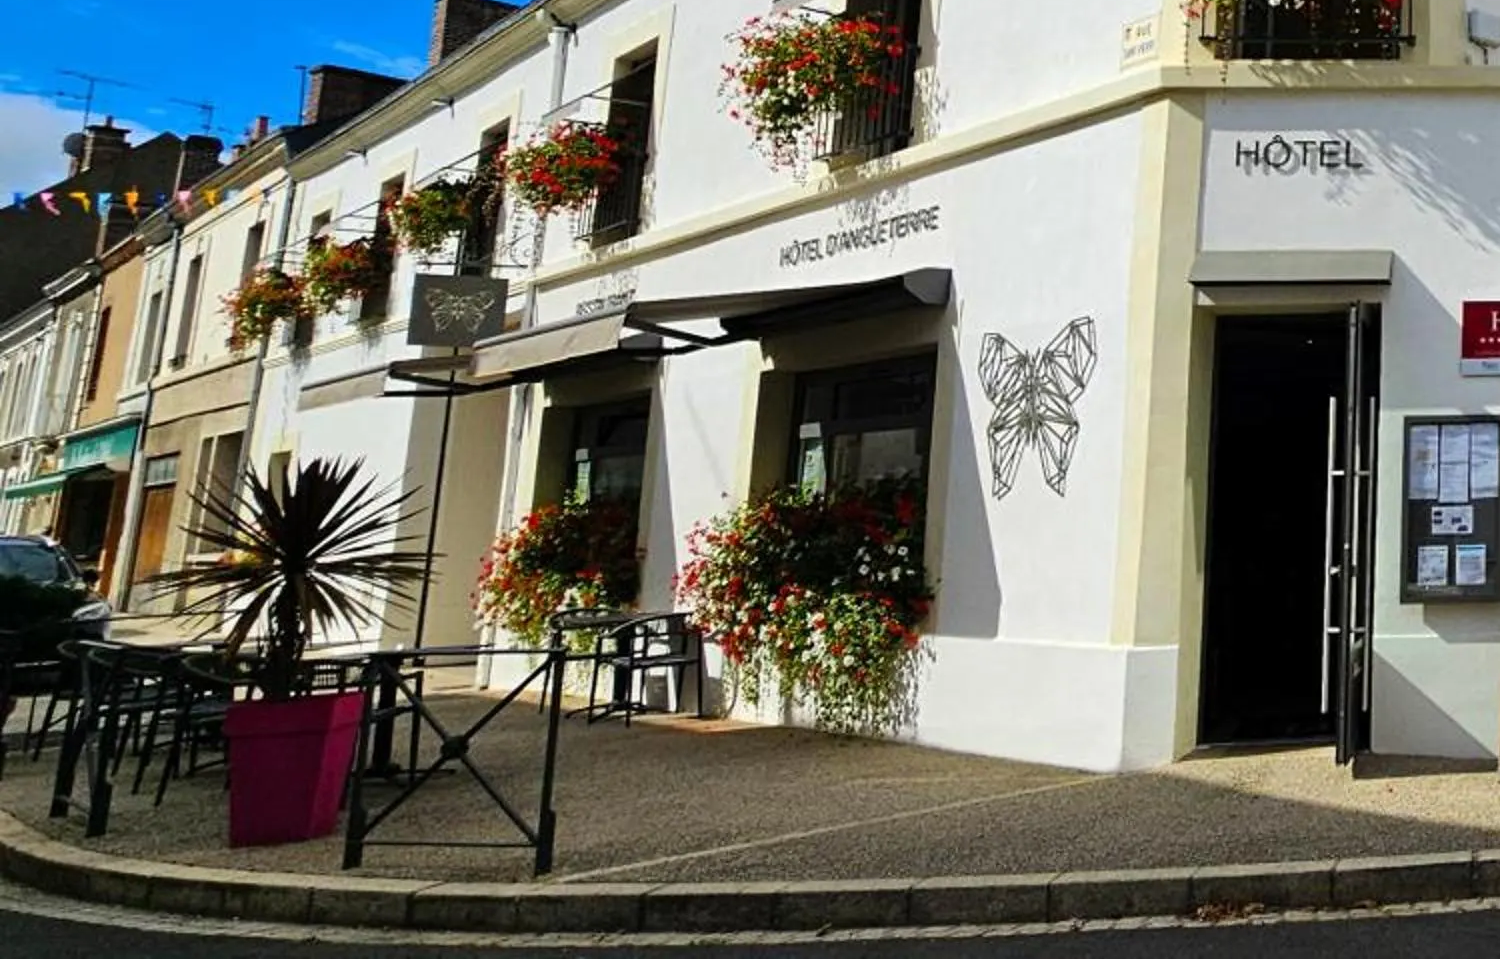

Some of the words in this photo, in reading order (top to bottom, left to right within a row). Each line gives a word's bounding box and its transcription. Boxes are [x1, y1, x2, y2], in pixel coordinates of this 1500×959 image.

[1236, 134, 1363, 167] HÔTEL
[779, 239, 823, 267] HÔTEL
[826, 205, 940, 257] D'ANGLETERRE
